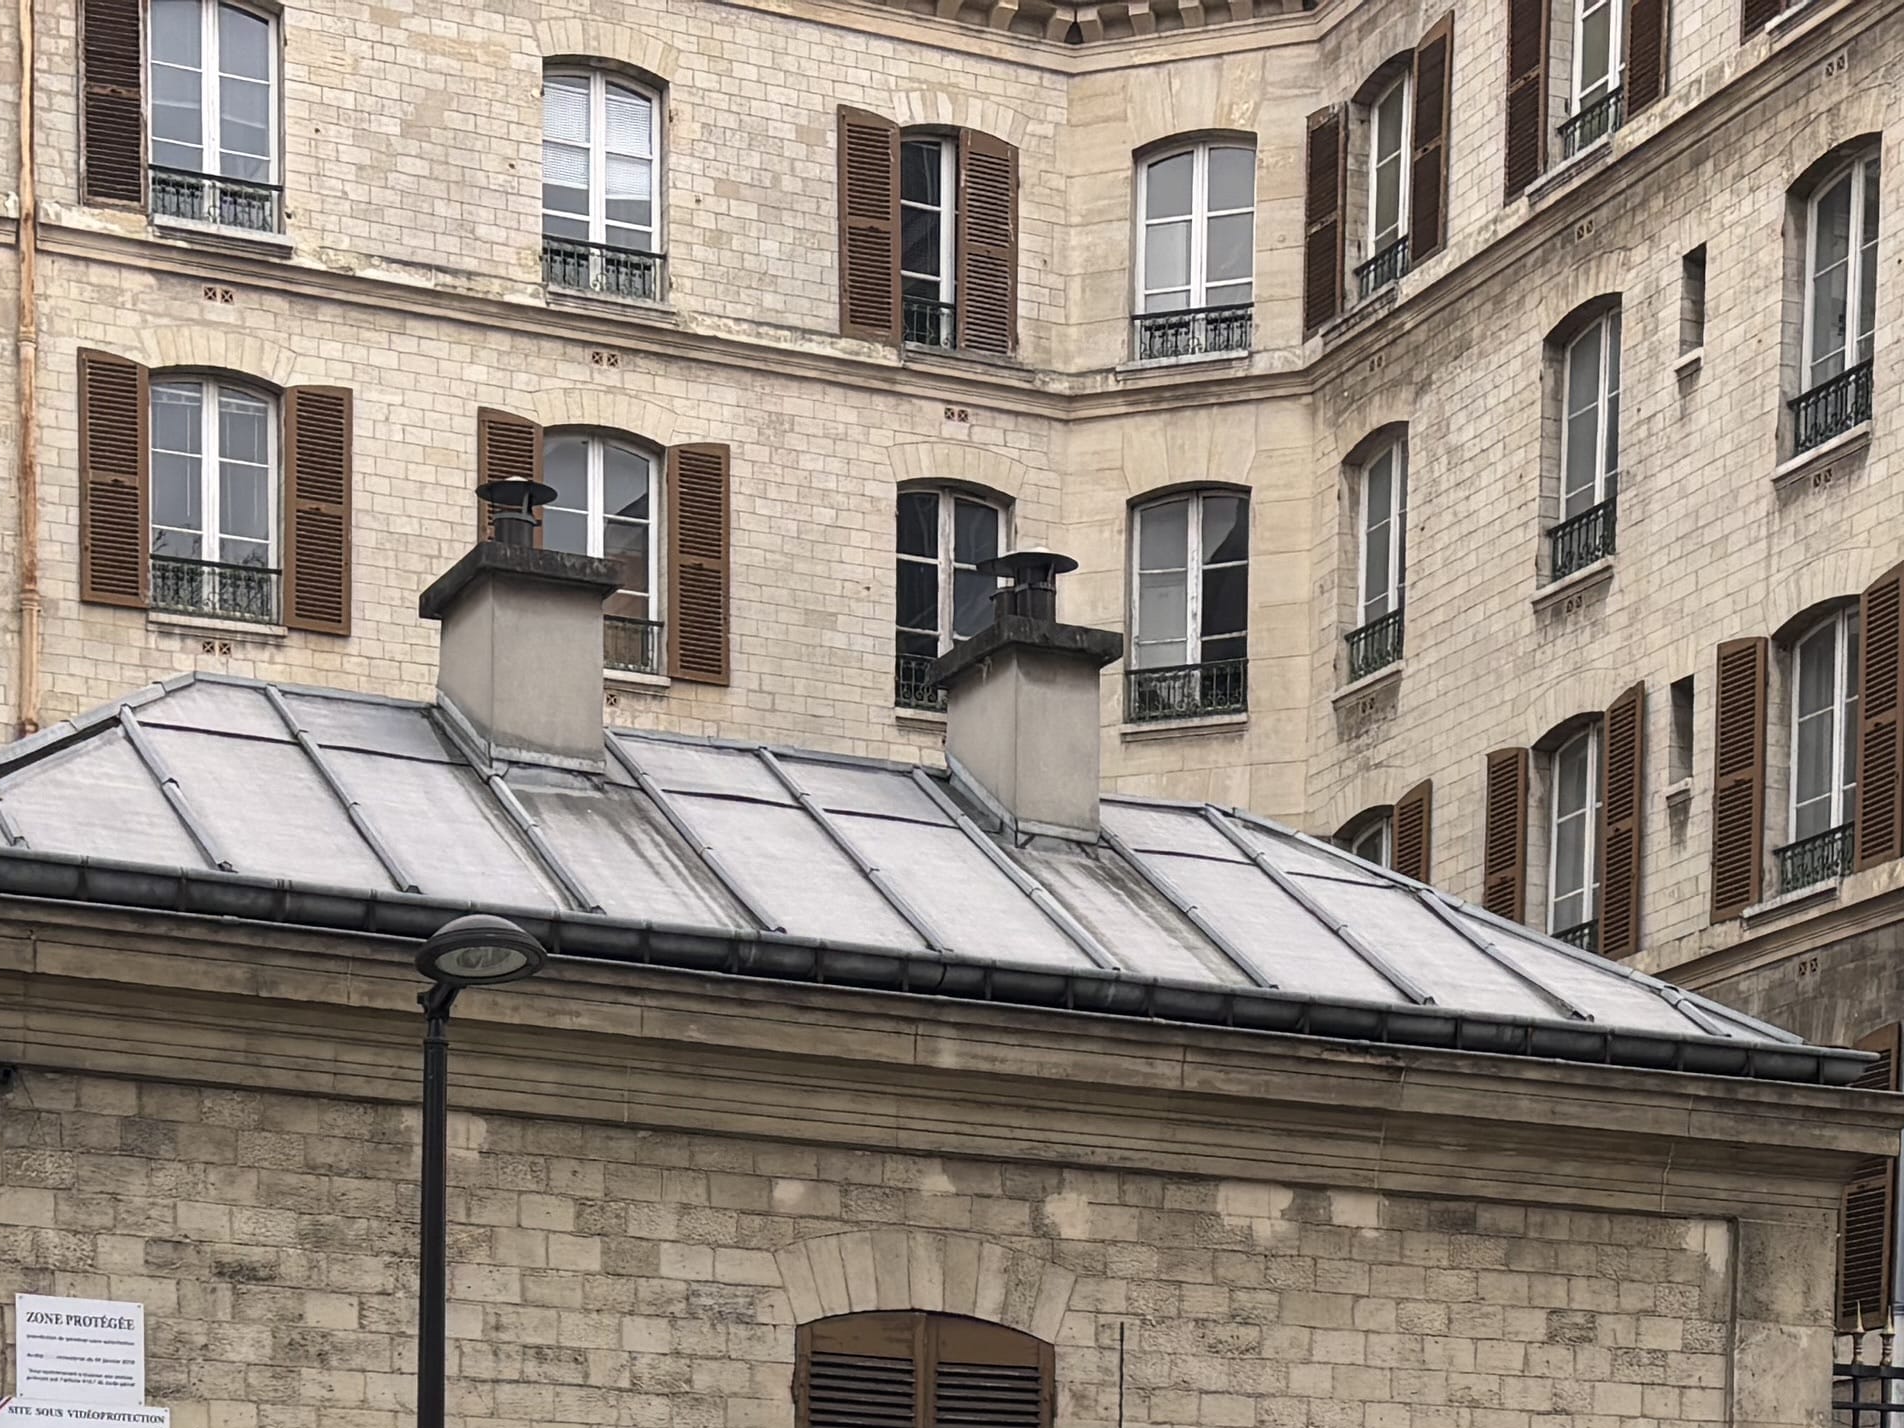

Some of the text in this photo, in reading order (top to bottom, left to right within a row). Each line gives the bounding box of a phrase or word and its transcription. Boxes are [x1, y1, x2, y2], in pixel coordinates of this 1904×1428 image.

[26, 1311, 135, 1331] ZONE PROTÉGÉE
[8, 1406, 165, 1424] SITE SOUS VIDÉOPROTECTION
